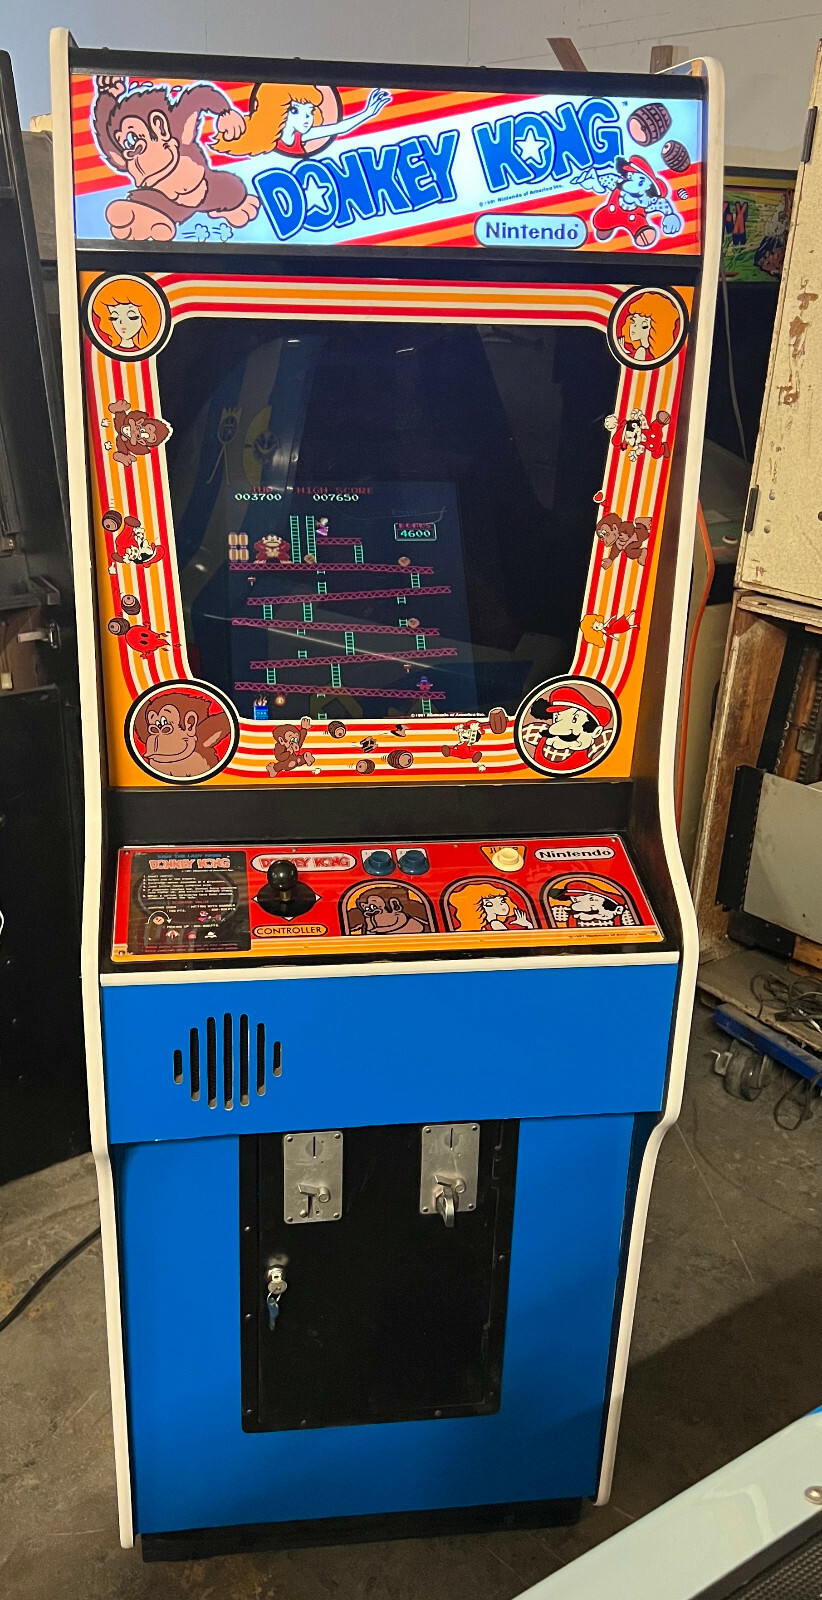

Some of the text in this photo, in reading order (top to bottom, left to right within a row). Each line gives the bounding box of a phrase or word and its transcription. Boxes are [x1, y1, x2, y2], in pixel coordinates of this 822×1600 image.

[252, 129, 459, 240] DONKEY
[472, 98, 623, 193] KONG
[497, 192, 523, 202] Nintendo
[529, 186, 553, 195] America
[485, 222, 579, 240] Nintendo
[296, 486, 329, 494] HIGH
[234, 493, 282, 501] 003700
[312, 493, 360, 502] 007650
[400, 529, 431, 538] 4600
[539, 849, 612, 859] Nintendo
[149, 857, 231, 870] DONKEY KONG
[313, 856, 351, 868] KONG
[256, 926, 322, 935] CONTROLLER
